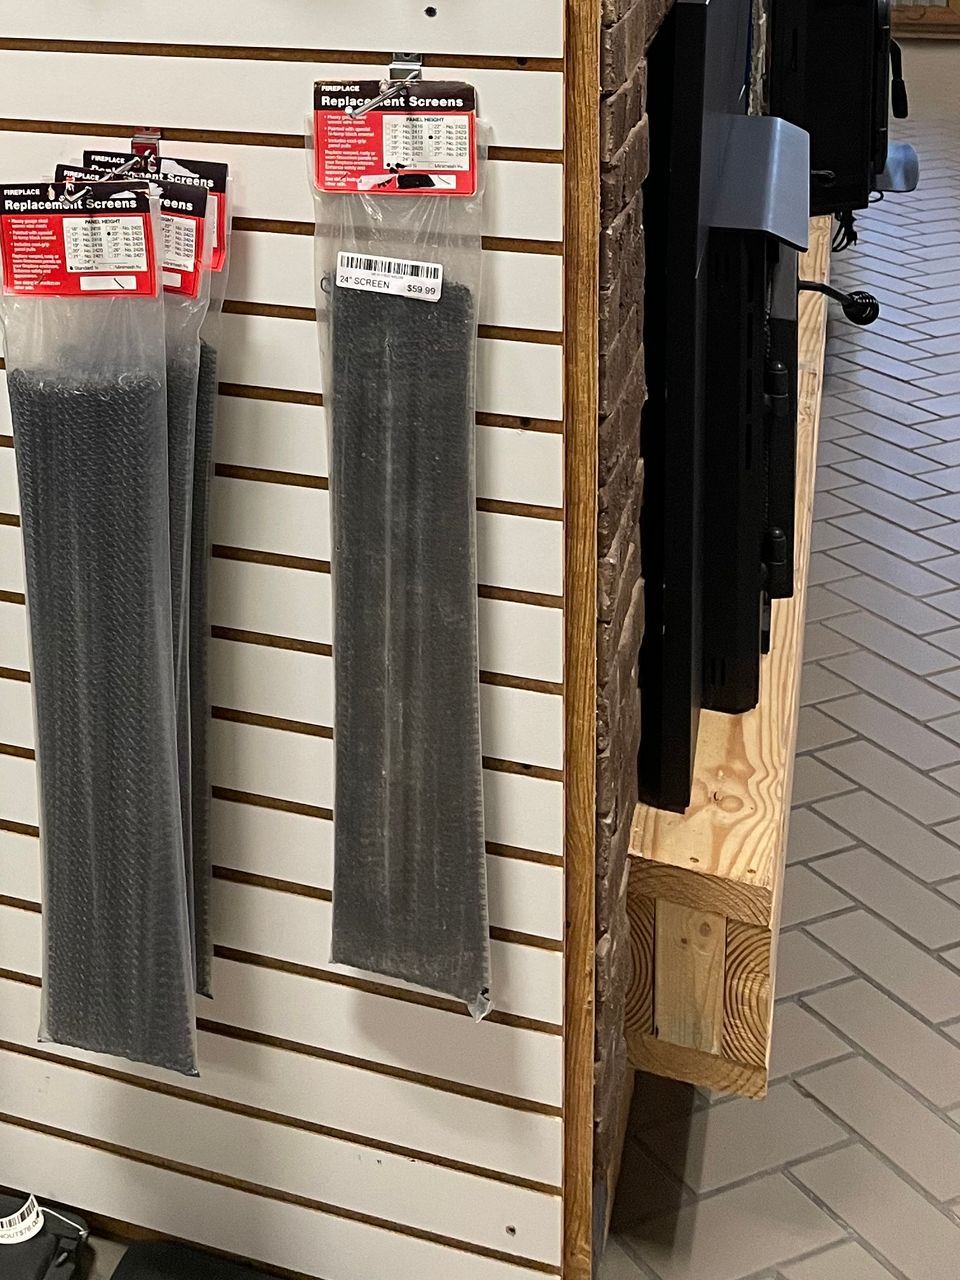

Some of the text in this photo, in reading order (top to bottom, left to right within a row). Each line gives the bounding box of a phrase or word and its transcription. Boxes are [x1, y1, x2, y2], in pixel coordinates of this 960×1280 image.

[321, 95, 464, 108] Replaceent Screens
[91, 155, 126, 164] FIREPLACE
[63, 170, 100, 180] FIREPLACE
[167, 172, 215, 188] Screens
[86, 199, 137, 209] Screens
[160, 199, 193, 211] reens
[340, 275, 436, 295] 24" SCREEN $59.99
